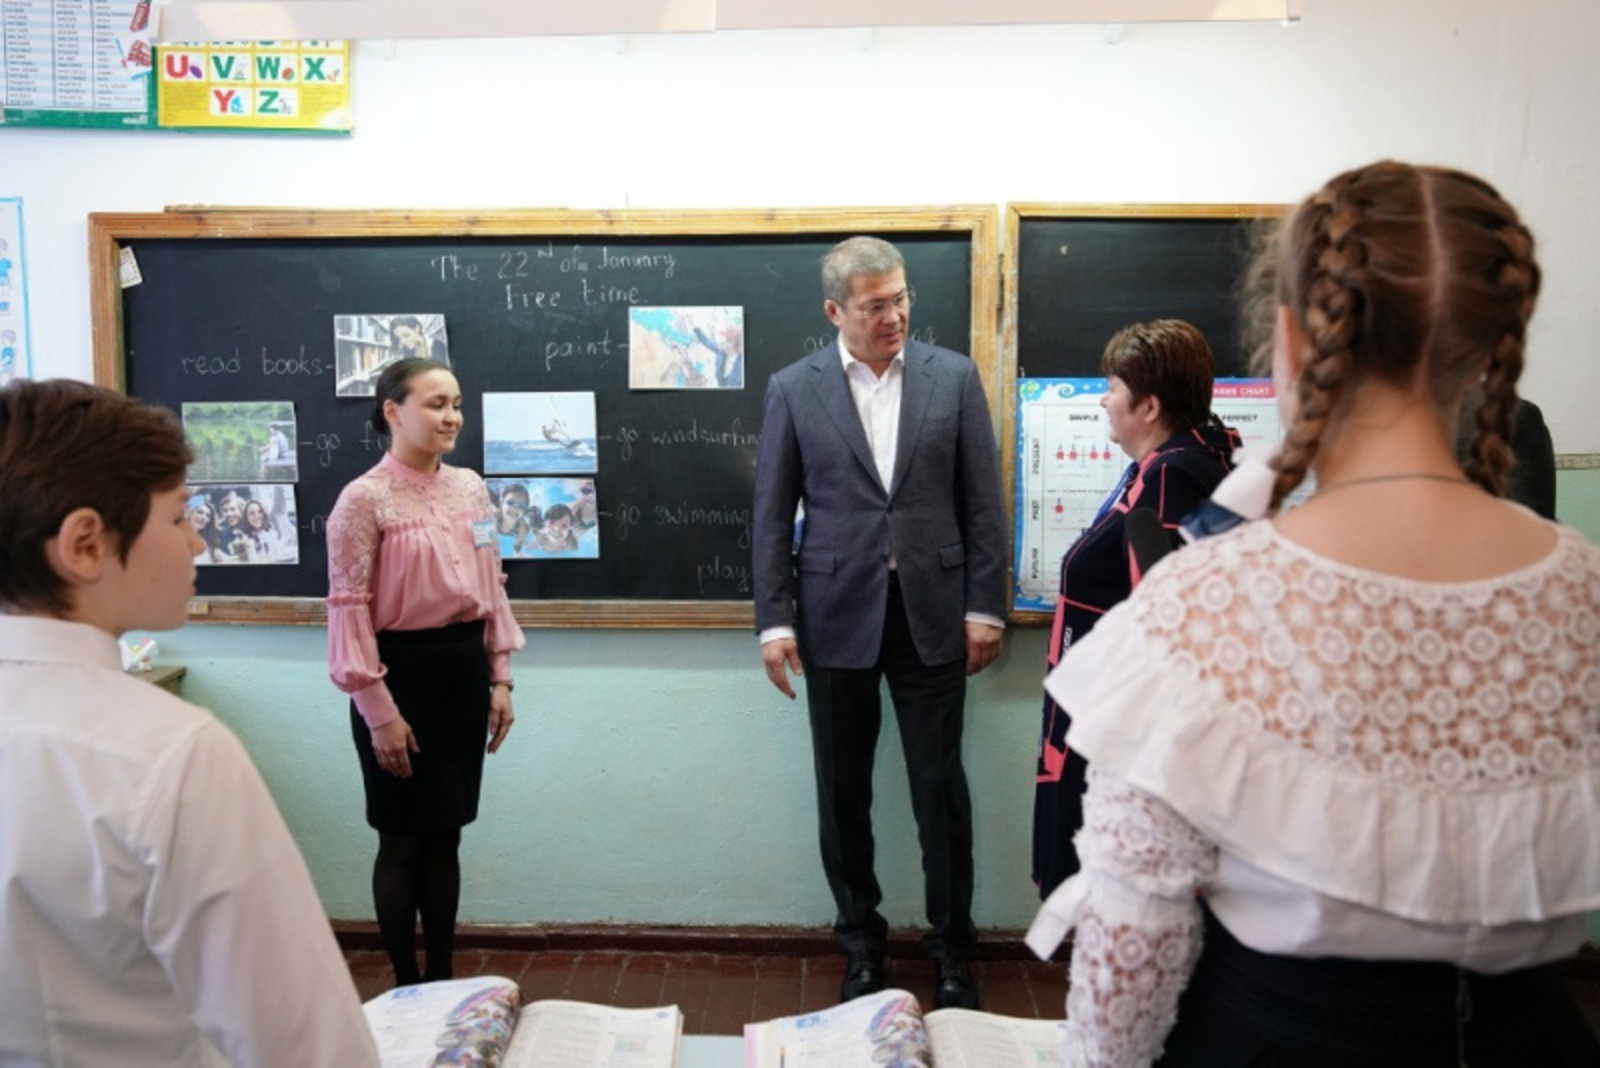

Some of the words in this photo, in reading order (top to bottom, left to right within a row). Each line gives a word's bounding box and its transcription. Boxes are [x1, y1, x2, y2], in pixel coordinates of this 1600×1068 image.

[166, 54, 189, 79] U
[211, 55, 235, 79] V
[256, 56, 281, 80] W
[303, 57, 326, 80] X
[213, 89, 236, 113] Y
[257, 91, 279, 113] Z
[430, 254, 479, 281] The
[598, 245, 677, 279] January
[505, 282, 561, 311] Free
[181, 344, 241, 375] read
